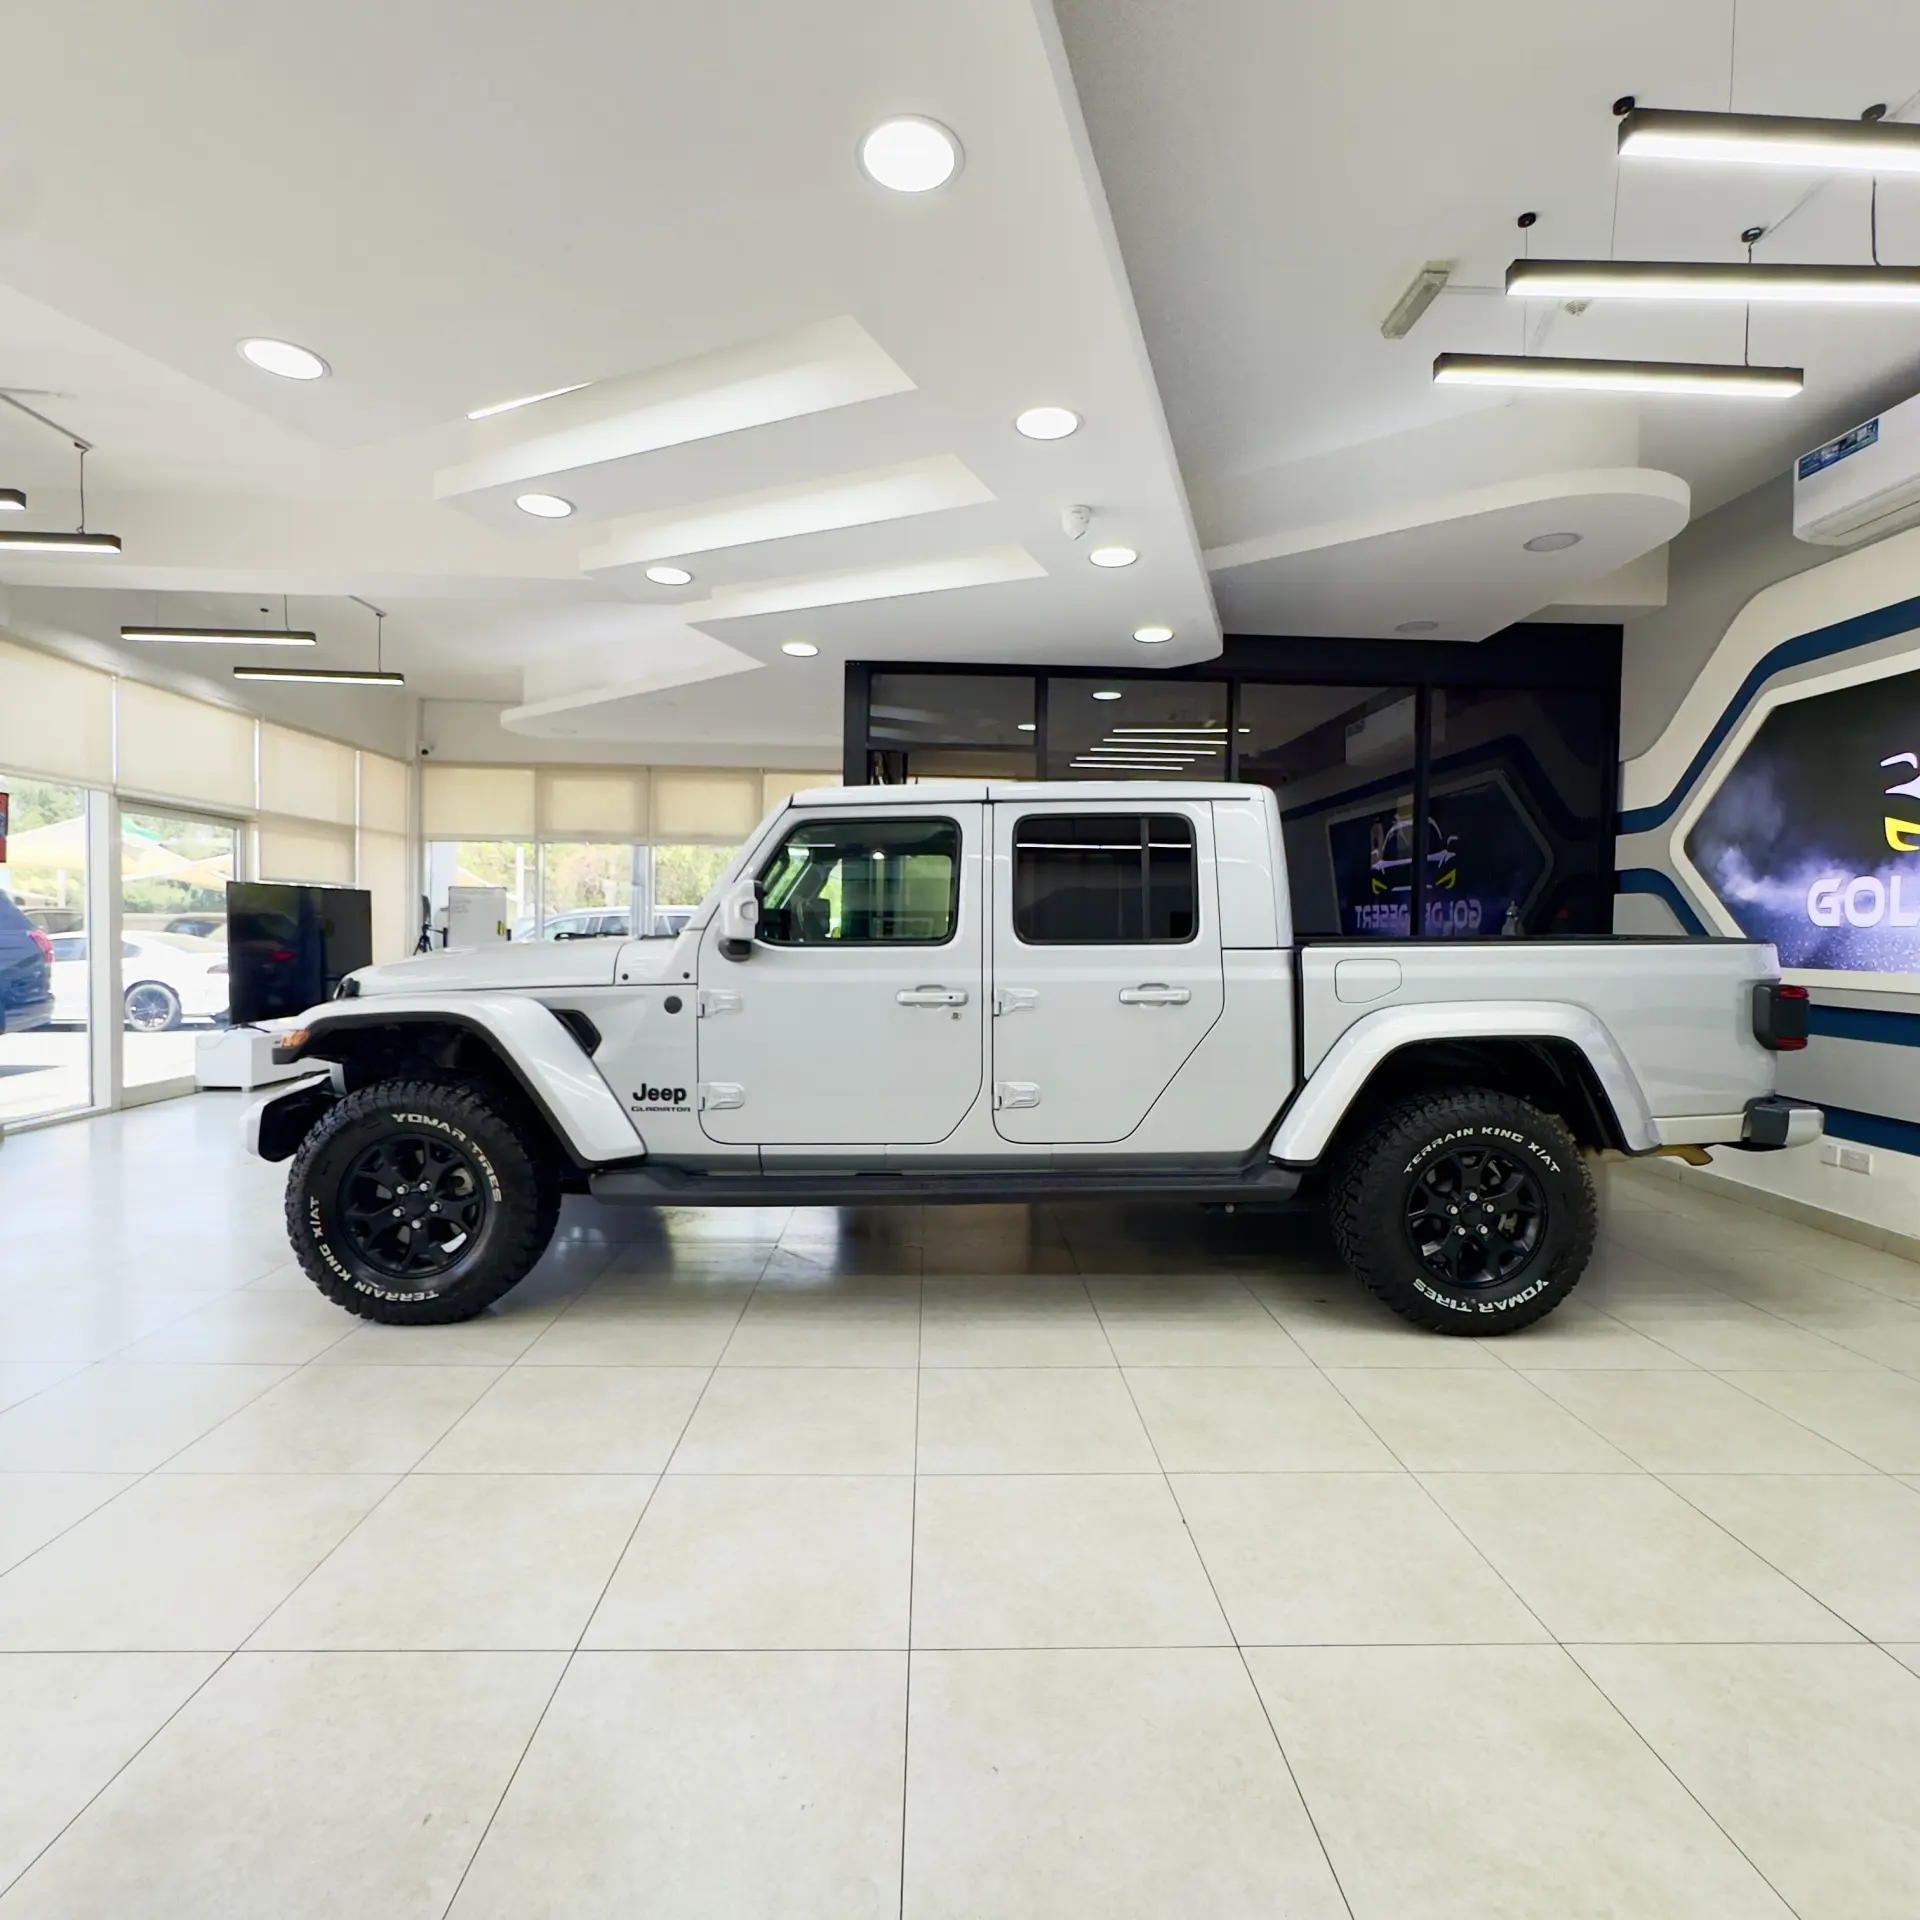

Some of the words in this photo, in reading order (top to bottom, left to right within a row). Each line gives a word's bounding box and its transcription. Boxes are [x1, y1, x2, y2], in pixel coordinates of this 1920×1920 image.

[632, 1083, 687, 1104] Jeep
[392, 1113, 466, 1142] YOMAR
[472, 1142, 502, 1202] TIRES
[1403, 1128, 1474, 1174] TERRAIN
[1482, 1127, 1524, 1143] KING
[318, 1244, 351, 1281] KING
[354, 1282, 439, 1302] TERRAIN
[1413, 1279, 1473, 1312] TIRES
[1478, 1280, 1549, 1313] YOMAR
